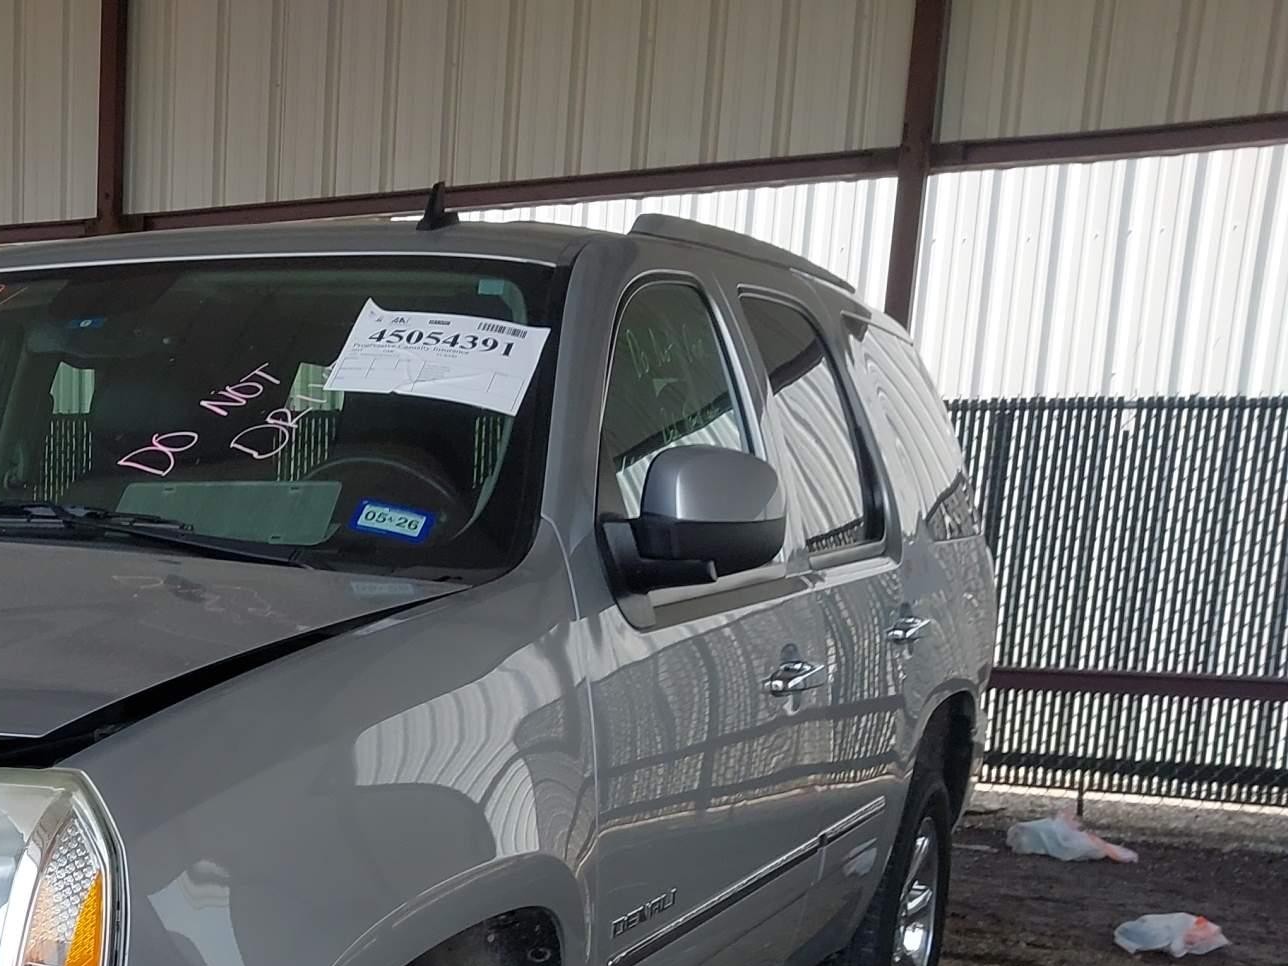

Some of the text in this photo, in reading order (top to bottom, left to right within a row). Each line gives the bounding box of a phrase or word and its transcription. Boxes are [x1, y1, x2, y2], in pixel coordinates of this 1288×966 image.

[368, 328, 515, 357] 45054391
[117, 362, 281, 477] DO NOT
[611, 888, 677, 939] DENALI
